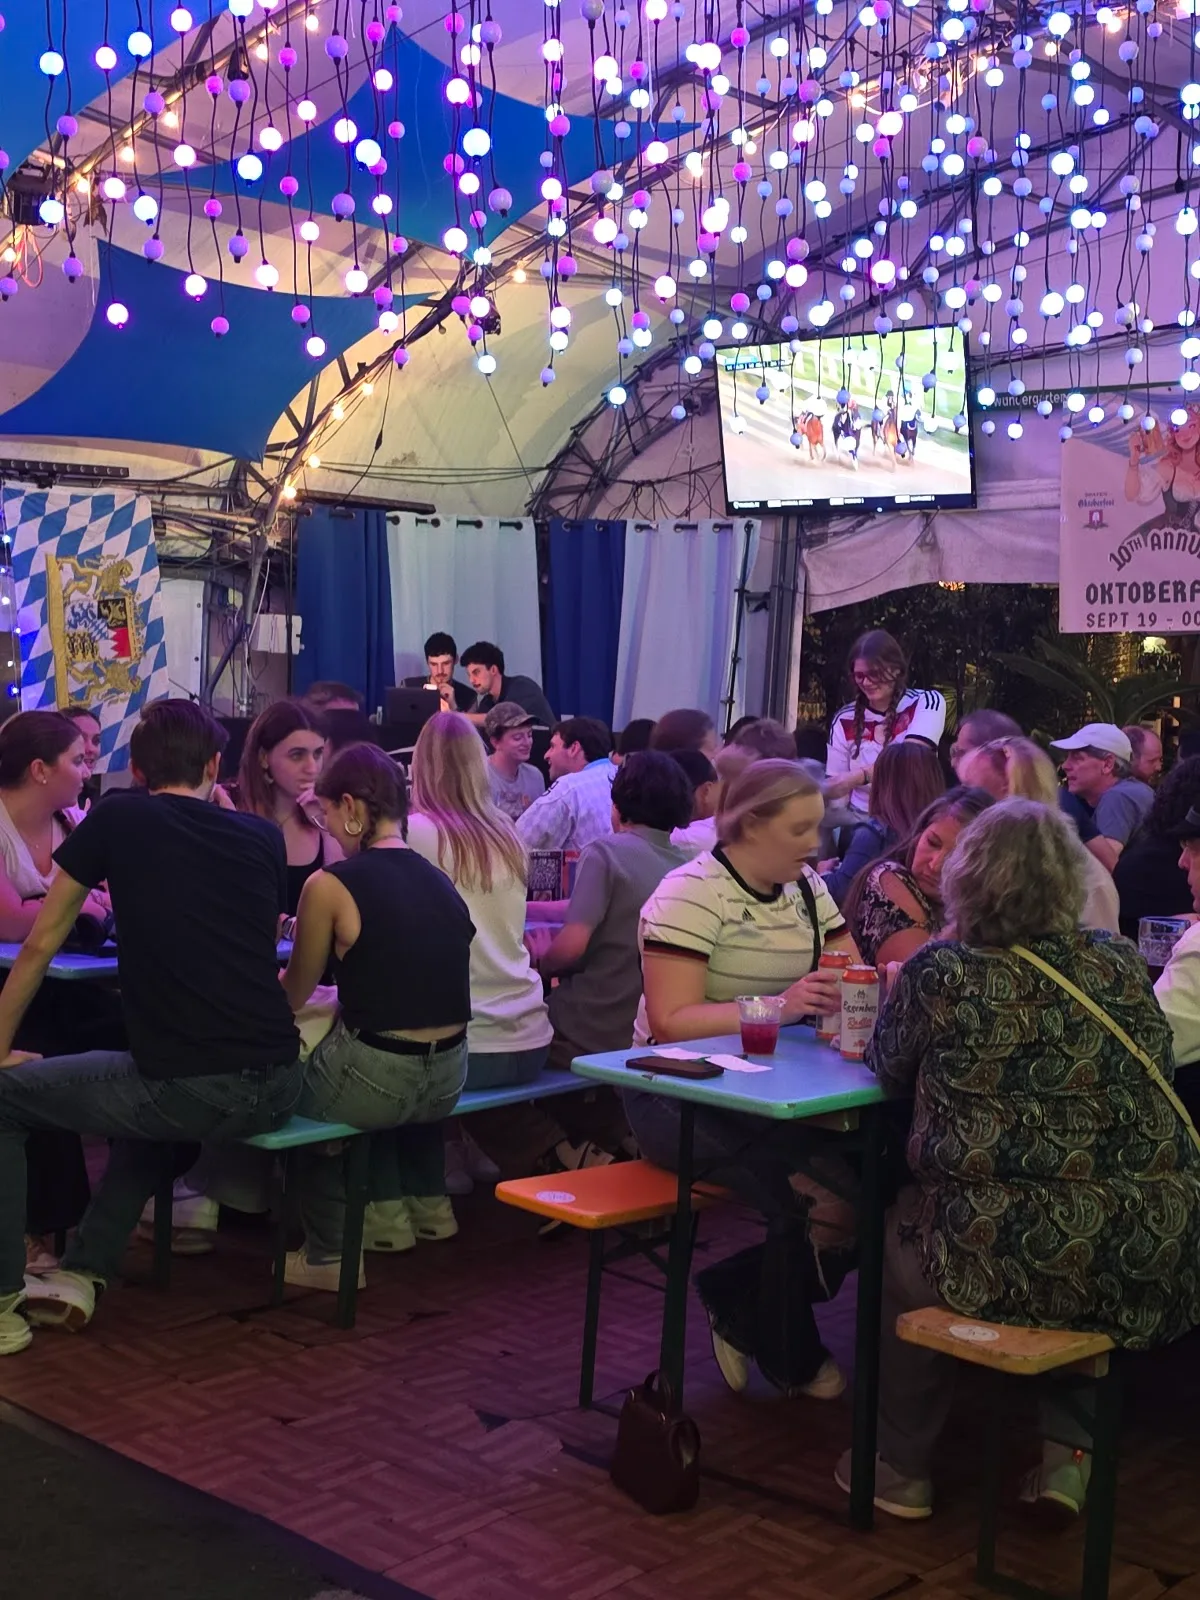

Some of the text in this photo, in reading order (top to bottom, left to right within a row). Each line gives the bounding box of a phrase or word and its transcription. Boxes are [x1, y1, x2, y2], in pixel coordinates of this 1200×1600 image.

[1109, 532, 1200, 572] 10TH ANNU
[1086, 612, 1129, 628] SEPT
[1137, 612, 1157, 627] 19
